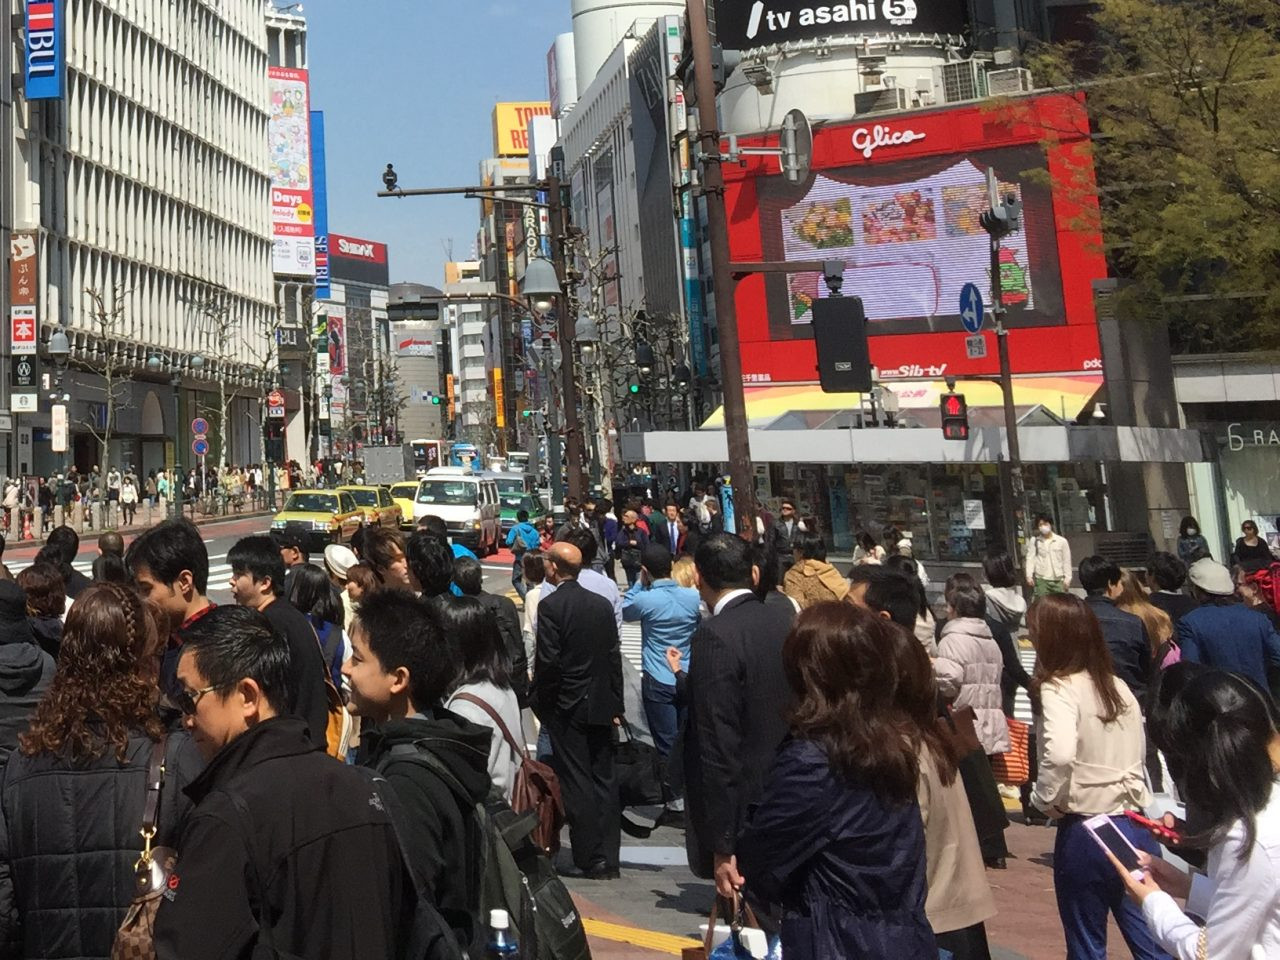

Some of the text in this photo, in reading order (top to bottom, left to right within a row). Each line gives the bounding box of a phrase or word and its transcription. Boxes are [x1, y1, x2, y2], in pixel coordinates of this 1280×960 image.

[766, 10, 791, 31] tv
[852, 128, 926, 158] Glico
[273, 191, 303, 207] Days
[15, 320, 33, 340] 本
